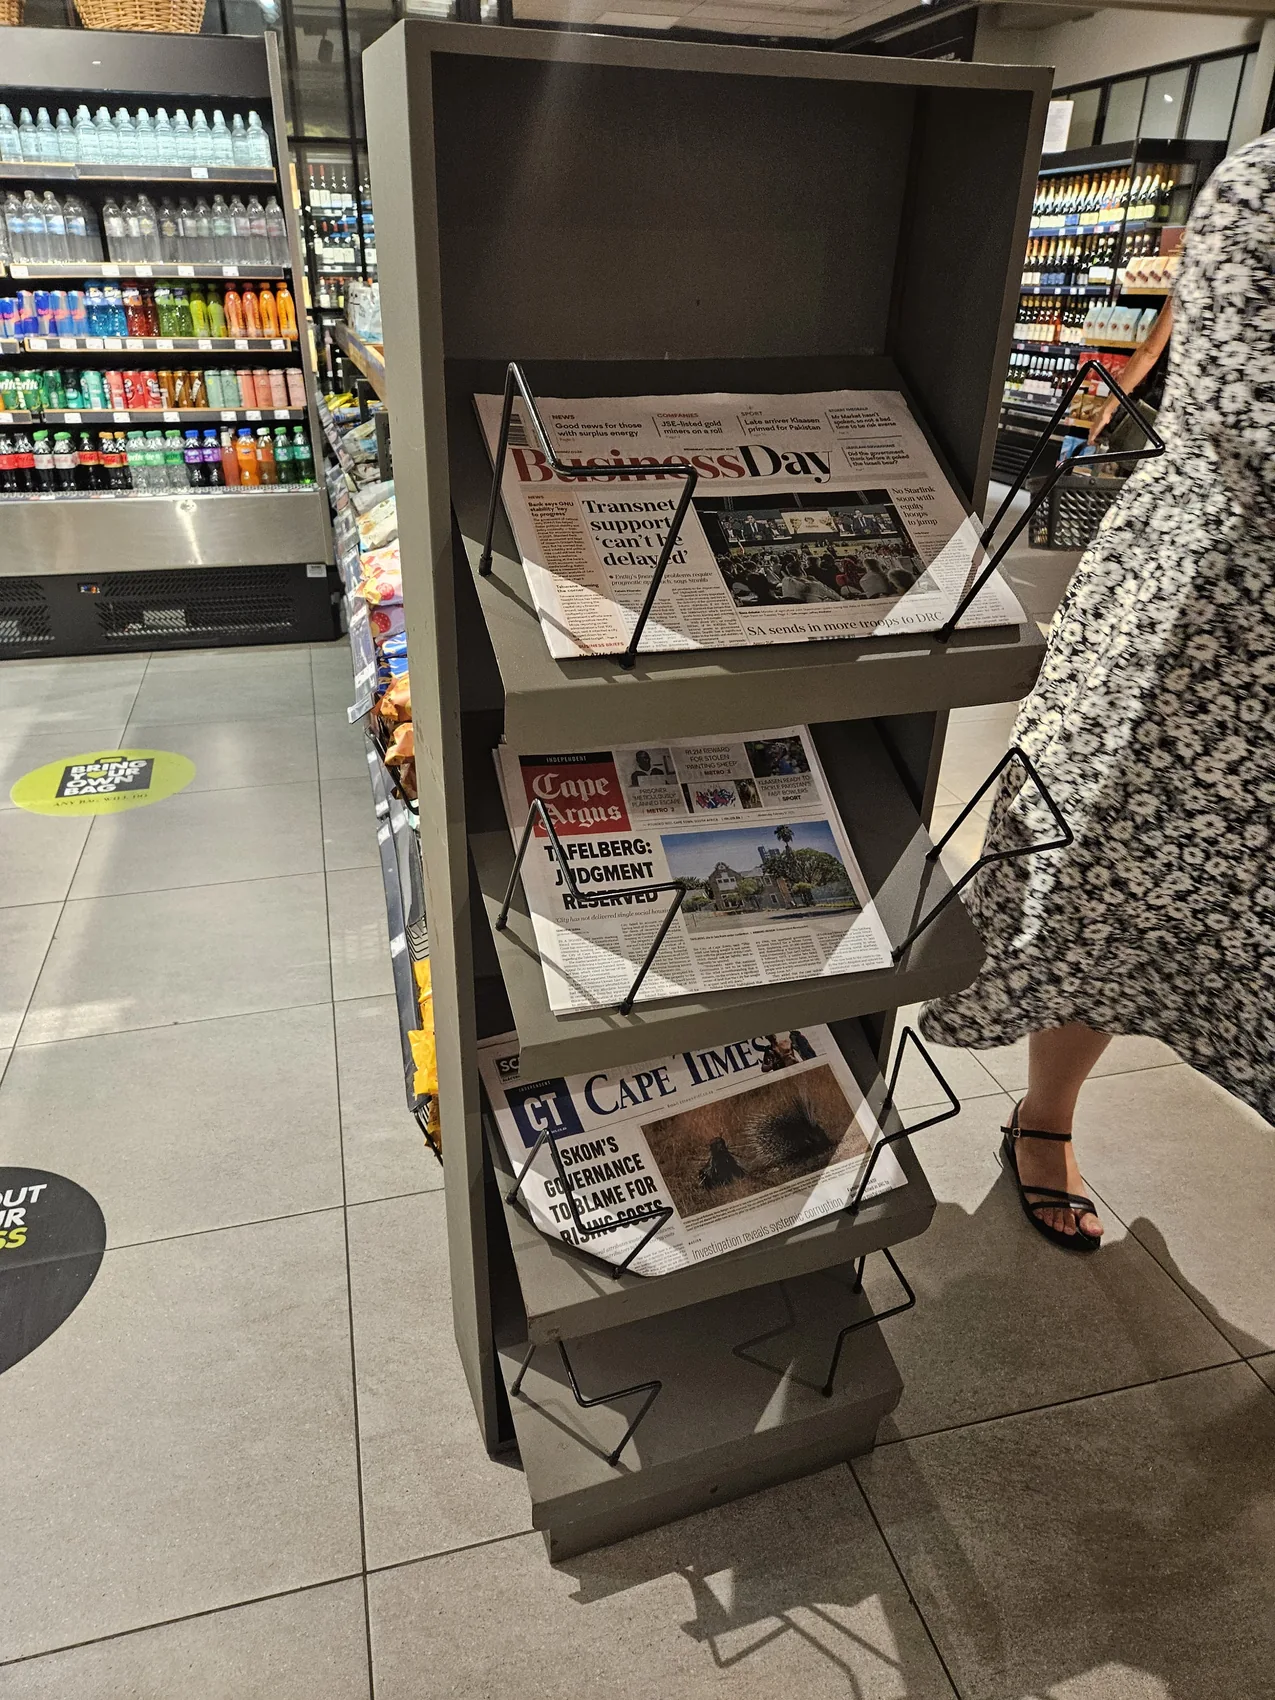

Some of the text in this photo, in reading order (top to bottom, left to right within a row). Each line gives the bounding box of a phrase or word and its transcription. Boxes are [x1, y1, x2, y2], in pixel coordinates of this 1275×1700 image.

[555, 422, 579, 430] Good
[618, 421, 643, 430] those
[704, 419, 722, 428] gold
[744, 418, 763, 426] Late
[789, 416, 821, 424] Klaasen
[557, 429, 639, 438] with surplus energy
[663, 427, 691, 435] miners
[748, 425, 776, 434] primed
[789, 423, 822, 431] Pakistan
[891, 485, 936, 495] No Starlink
[916, 493, 935, 501] with
[581, 498, 679, 514] Transnet
[900, 502, 924, 511] equity
[903, 510, 929, 519] hoops
[589, 516, 673, 534] support
[916, 518, 938, 527] jump
[656, 533, 685, 547] be
[663, 572, 691, 580] problems
[691, 570, 713, 579] require
[611, 578, 641, 586] pragmatic
[747, 625, 767, 636] SA
[769, 621, 805, 635] sends
[808, 621, 822, 632] in
[823, 619, 858, 632] more
[858, 616, 900, 630] troops
[900, 614, 914, 625] to
[915, 611, 946, 624] DRC
[606, 640, 625, 648] BRIEFS
[703, 746, 731, 754] REWARD
[546, 755, 587, 763] INDEPENDENT
[704, 753, 730, 761] STOLEN
[70, 759, 148, 774] BRING
[66, 774, 134, 788] OWN
[63, 785, 118, 797] BAG
[532, 772, 610, 803] Cape
[639, 787, 668, 795] PRISONER
[781, 787, 809, 796] BOWLERS
[632, 798, 681, 808] PLANNED ESCAPE
[782, 794, 802, 802] SPORT
[53, 800, 75, 808] ANY
[538, 802, 623, 830] Argus
[562, 889, 659, 910] RESERVED
[591, 912, 618, 921] delivered
[617, 910, 635, 919] single
[634, 909, 651, 917] social
[499, 1057, 520, 1072] SC
[584, 1035, 772, 1116] CAPE TIMES
[523, 1091, 563, 1132] CT
[552, 1136, 620, 1167] SKOM'S
[543, 1153, 646, 1198] GOVERNANCE
[0, 1183, 48, 1208] UT
[548, 1175, 659, 1223] TO BLAME FOR
[692, 1234, 743, 1261] Investigation
[741, 1226, 770, 1241] reveals
[769, 1211, 804, 1234] systemic
[803, 1196, 844, 1220] corruption
